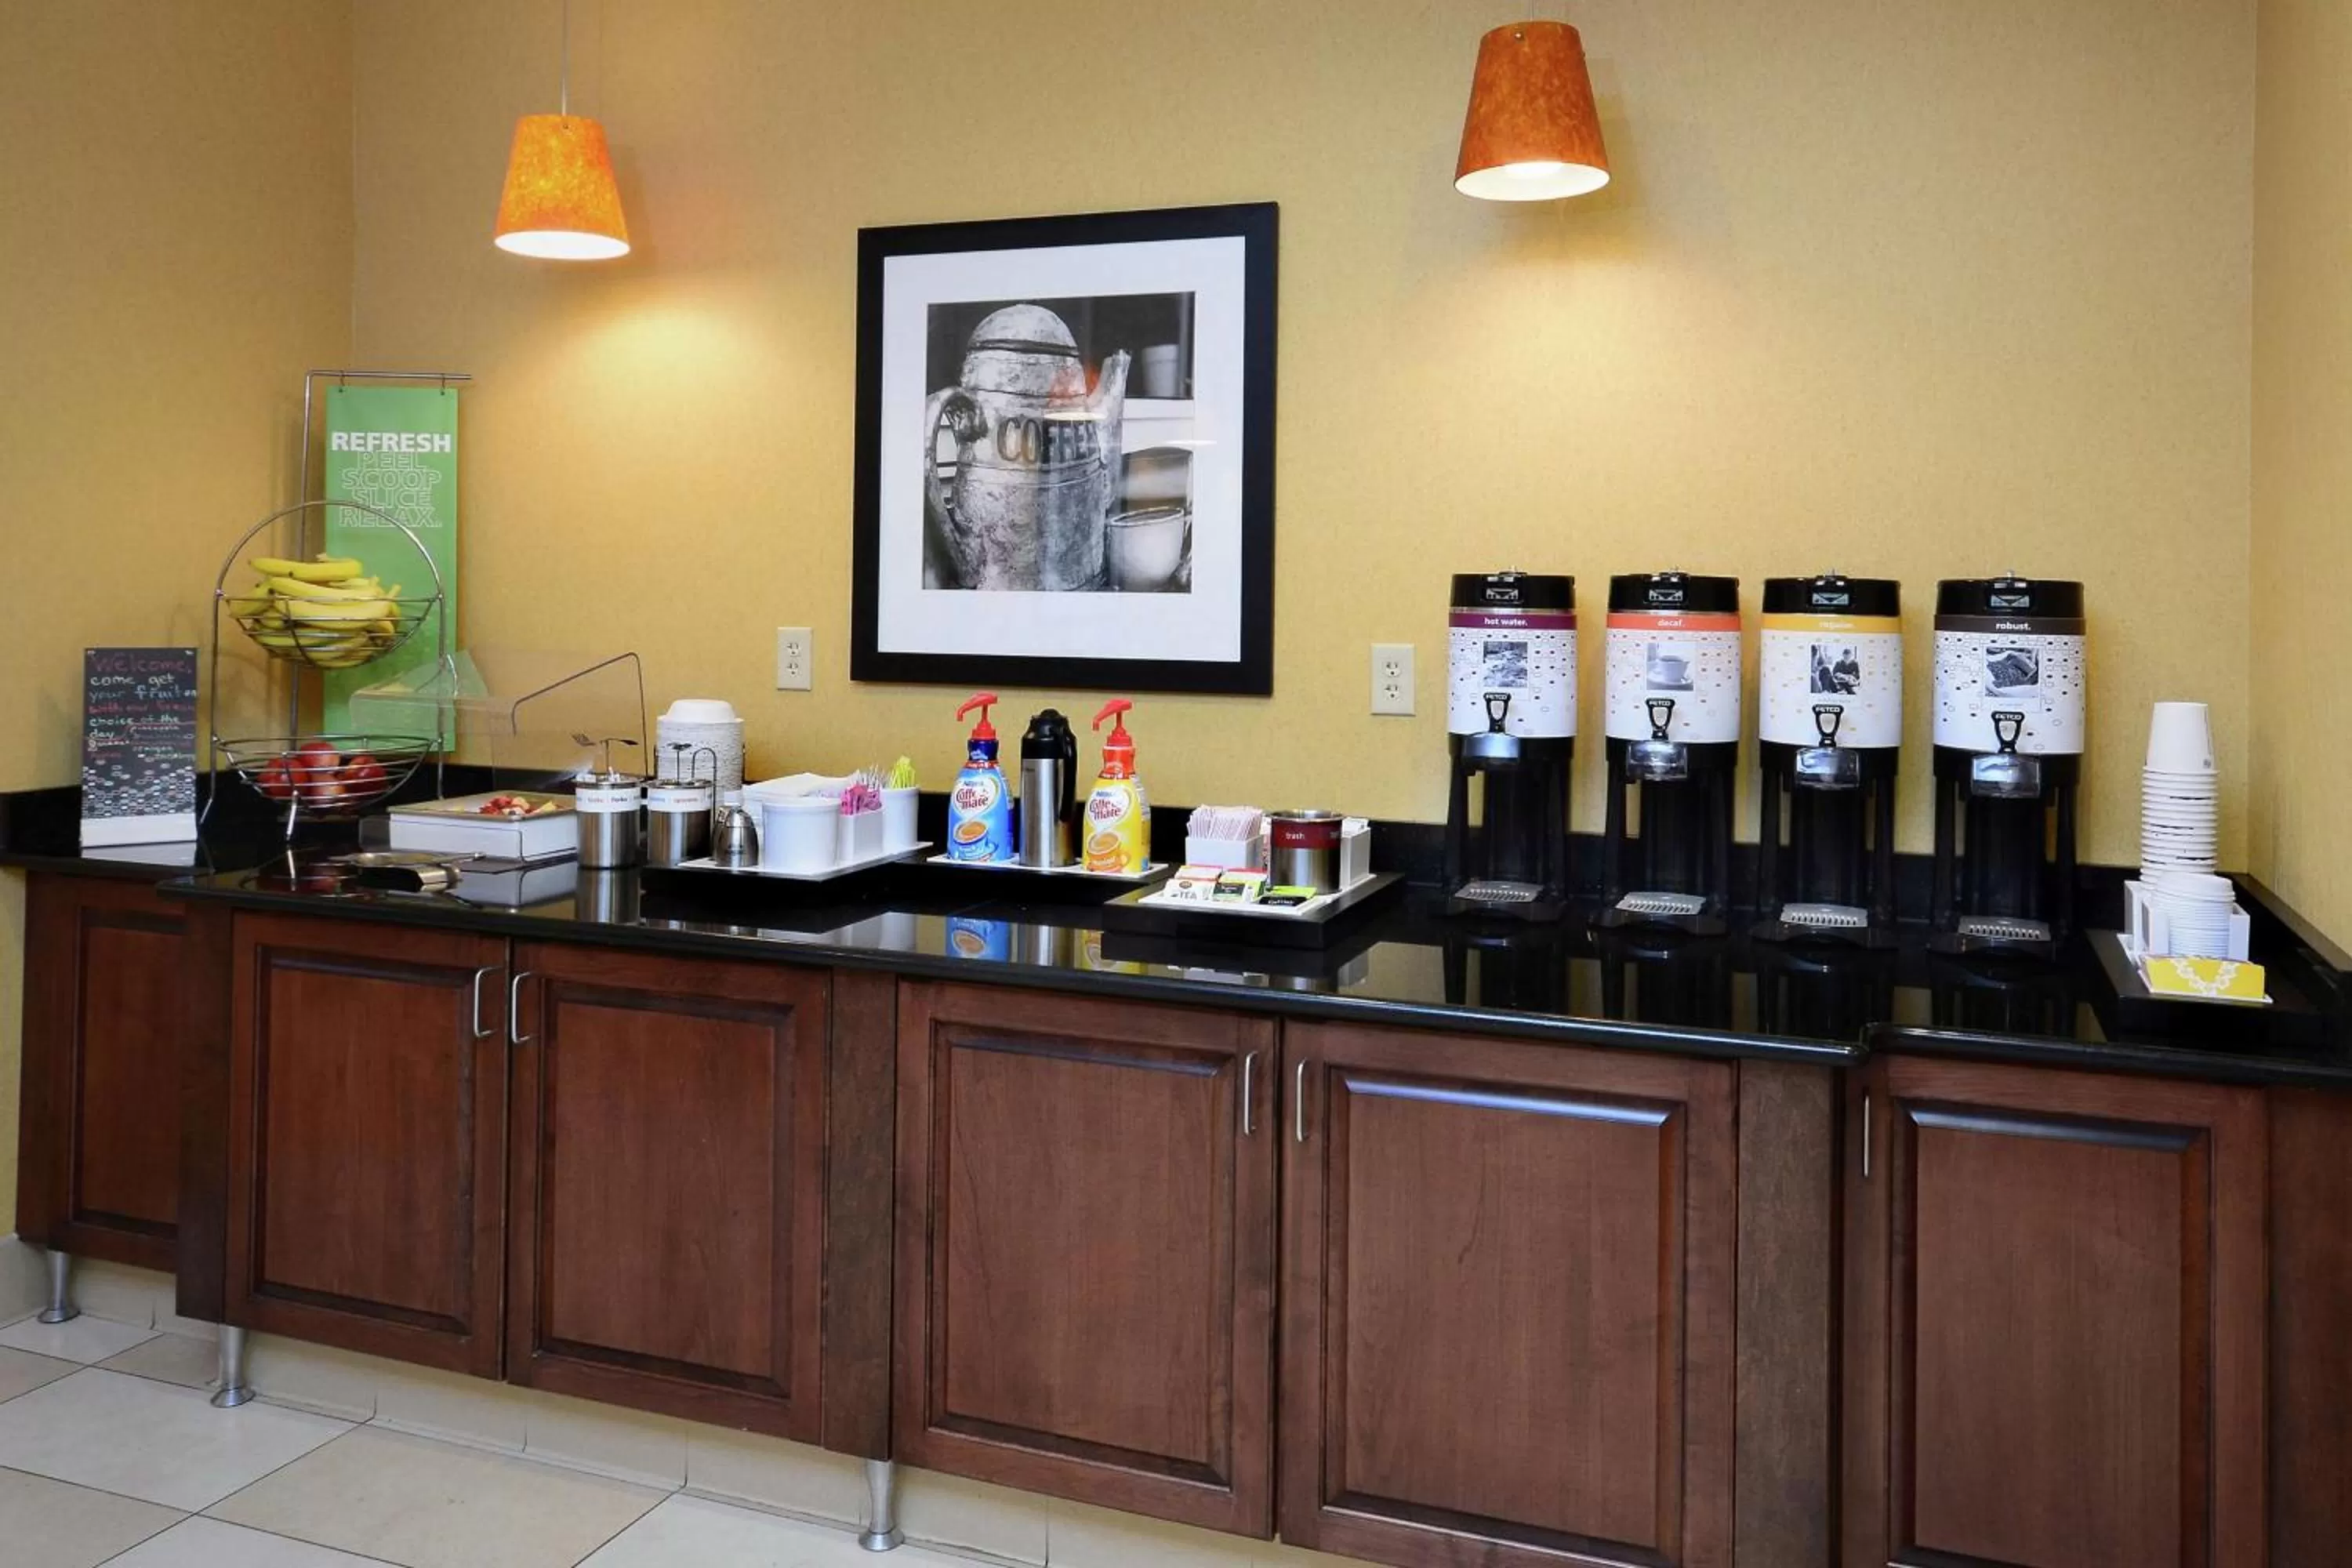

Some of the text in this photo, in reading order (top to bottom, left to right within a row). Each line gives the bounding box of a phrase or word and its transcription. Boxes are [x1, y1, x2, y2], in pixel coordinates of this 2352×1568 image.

[332, 432, 451, 452] REFRESH
[358, 450, 426, 470] PEEL
[342, 469, 442, 490] SCOOP
[352, 488, 433, 509] SLICE
[1484, 617, 1499, 626] hot
[148, 673, 176, 688] get
